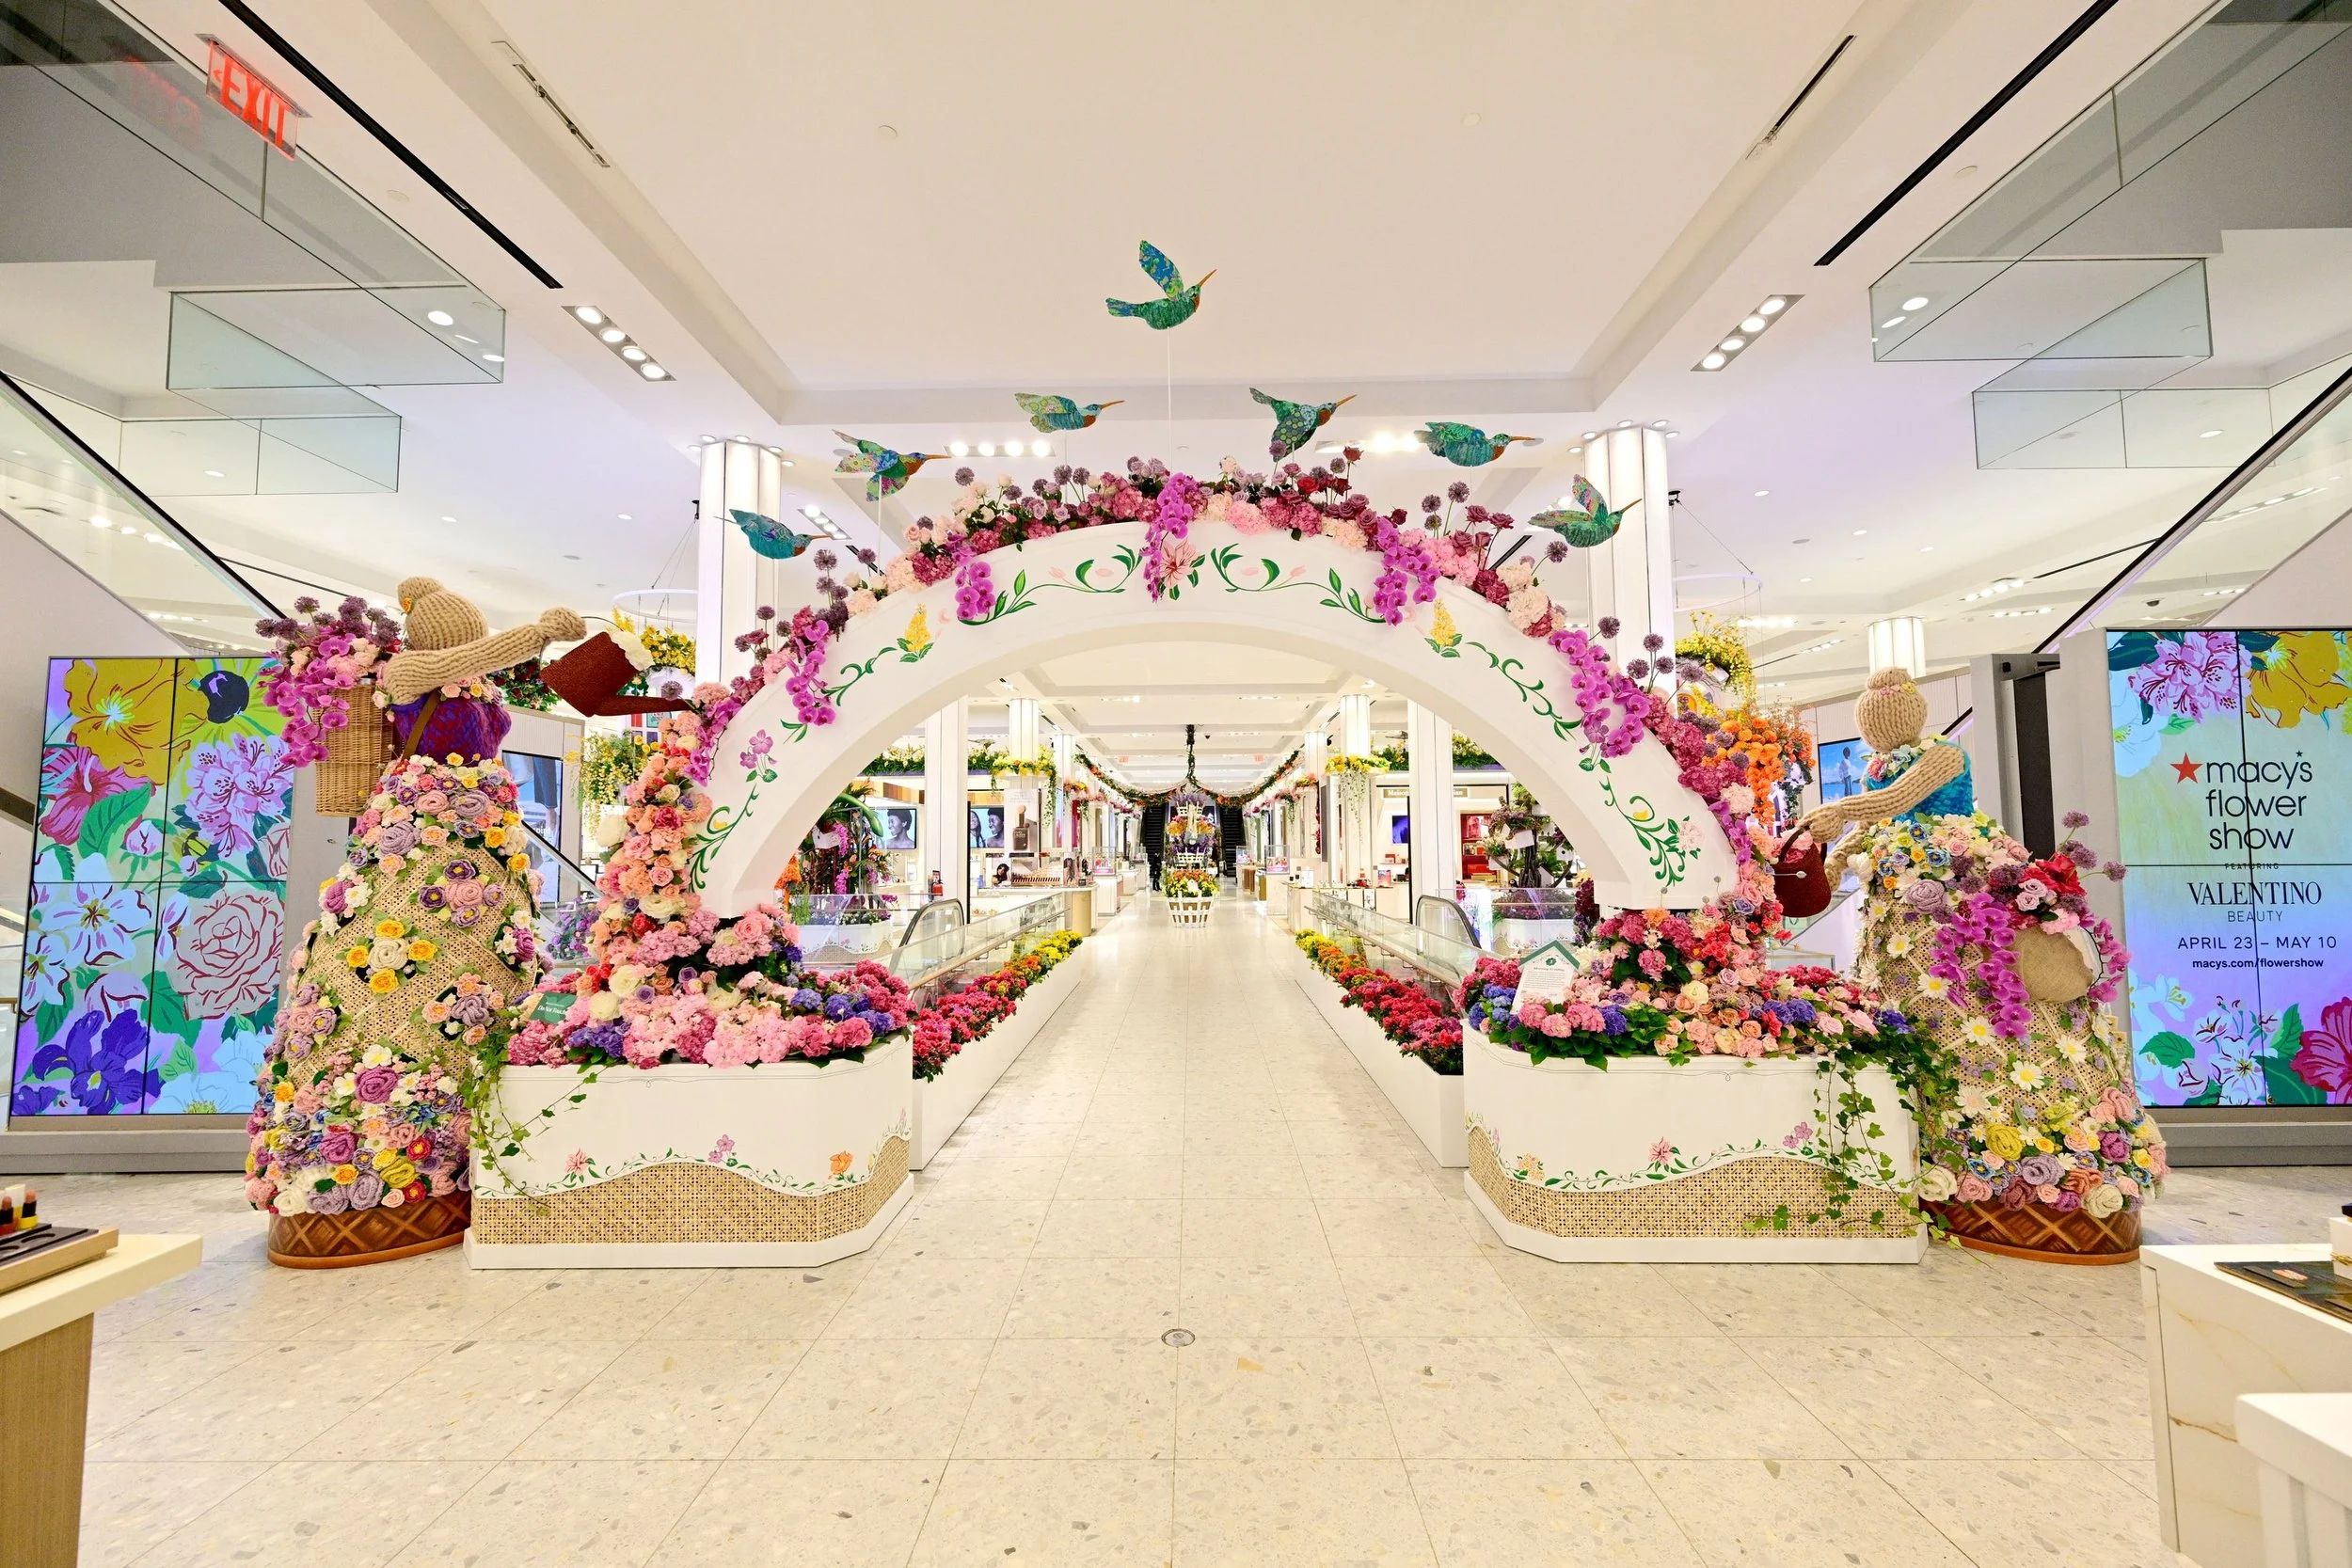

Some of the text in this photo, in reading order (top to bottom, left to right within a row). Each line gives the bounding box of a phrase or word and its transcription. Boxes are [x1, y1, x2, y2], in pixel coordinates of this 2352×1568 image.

[220, 55, 293, 147] EXIT
[2205, 789, 2308, 817] flower
[2209, 822, 2295, 849] show
[2186, 880, 2322, 905] VALENTINO
[2228, 910, 2283, 922] BEAUTY
[2177, 937, 2227, 949] APRIL
[2233, 937, 2253, 949] 23
[2276, 936, 2312, 948] MAY
[2318, 936, 2337, 948] 10
[2192, 958, 2324, 970] macys.com/flowershow
